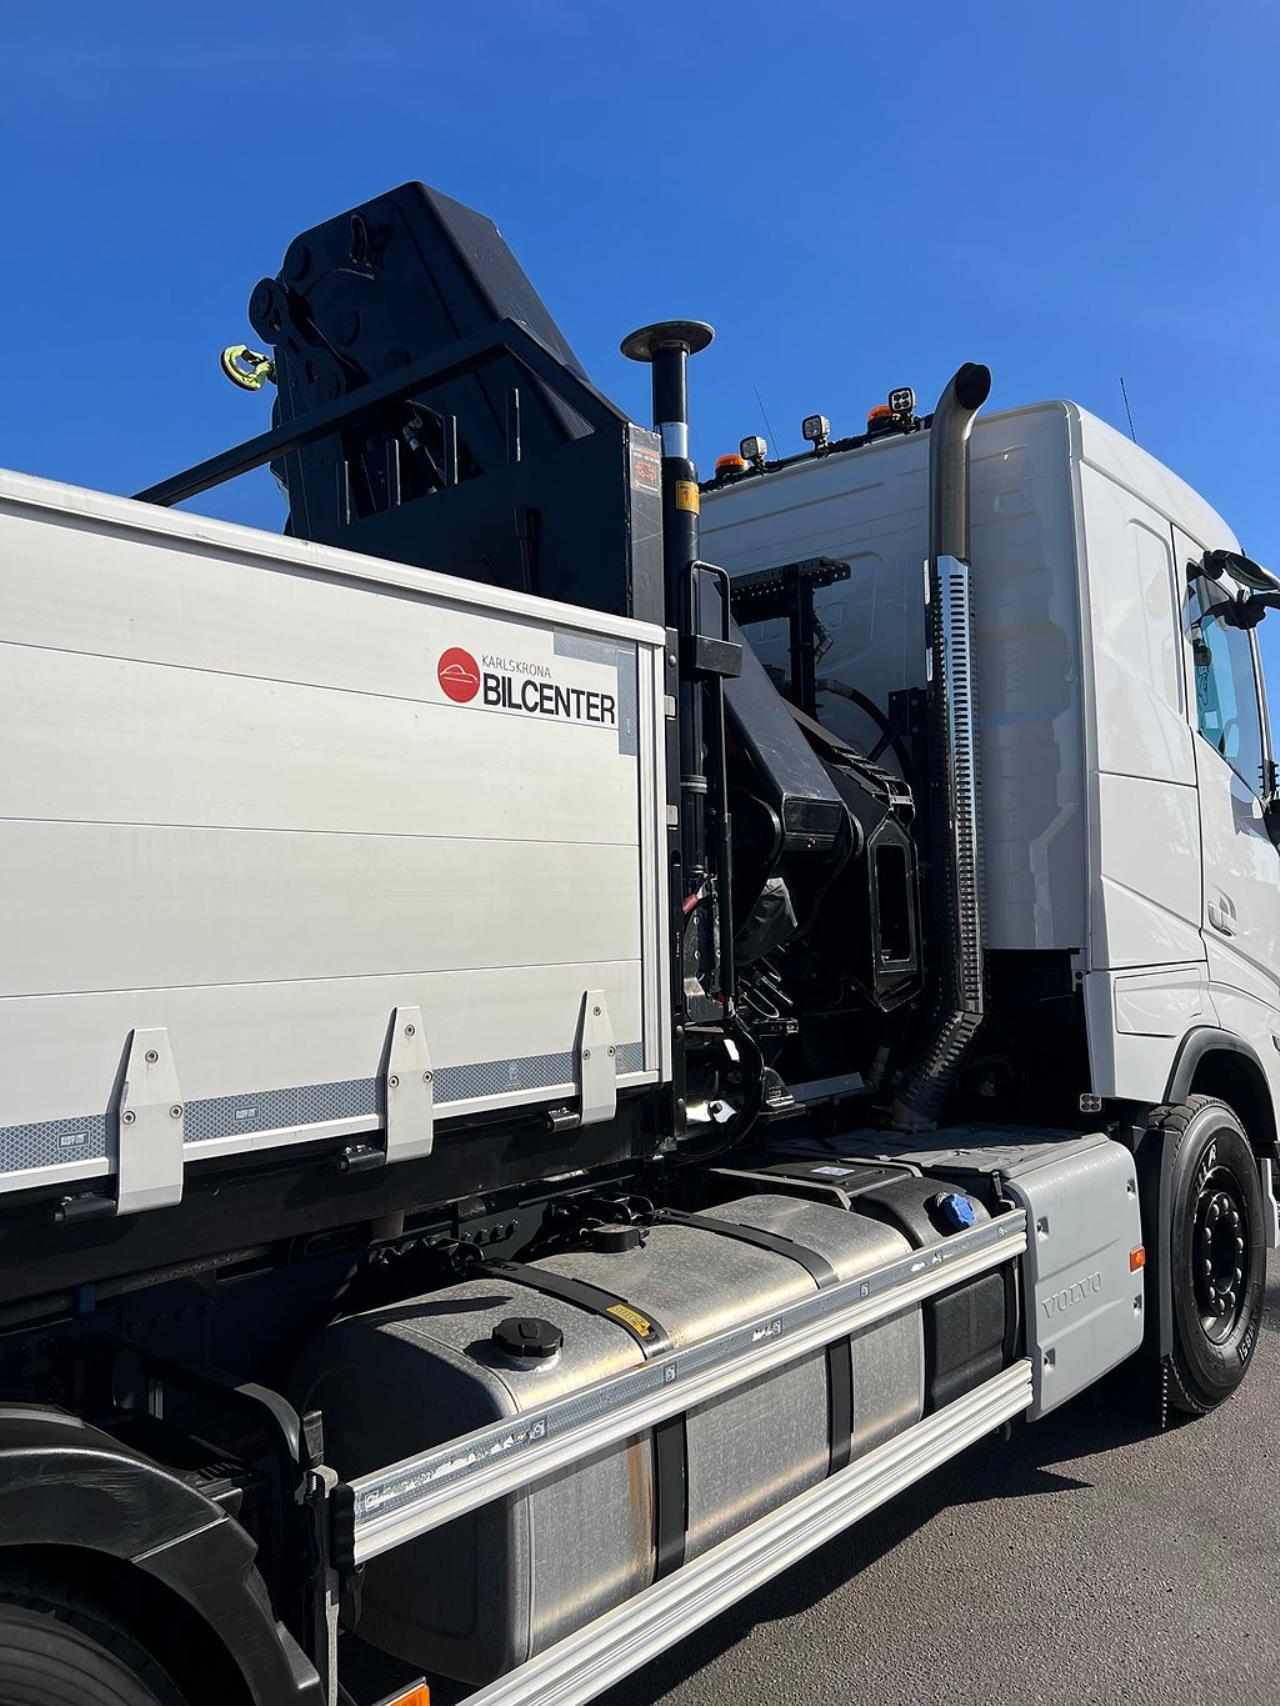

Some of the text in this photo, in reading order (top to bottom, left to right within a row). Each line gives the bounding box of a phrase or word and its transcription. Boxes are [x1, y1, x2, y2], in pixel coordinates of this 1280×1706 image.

[482, 654, 552, 679] KARLSKRONA
[483, 672, 616, 724] BILCENTER
[1041, 1271, 1102, 1319] VOLVO
